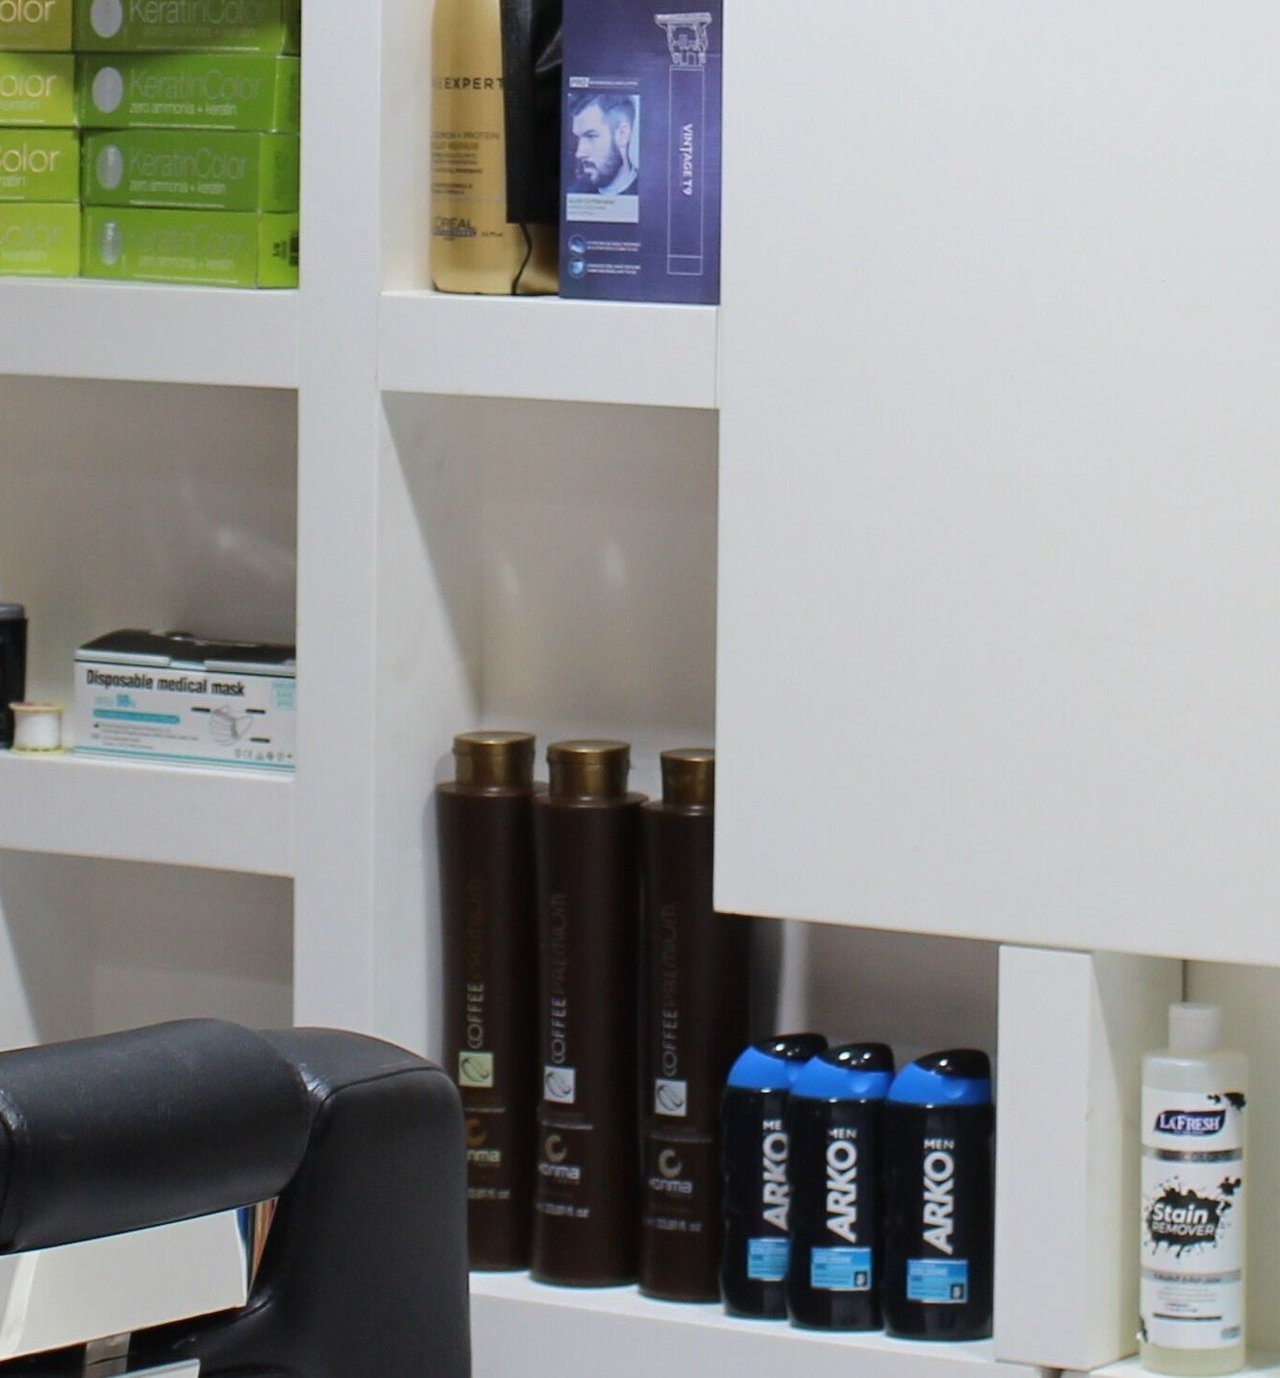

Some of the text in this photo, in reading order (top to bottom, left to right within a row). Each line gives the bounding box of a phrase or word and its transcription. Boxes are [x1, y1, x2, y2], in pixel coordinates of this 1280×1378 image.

[129, 68, 262, 101] KeratinColor
[444, 77, 504, 90] EXPERT
[86, 668, 245, 696] Disposable medical mask
[465, 981, 486, 1049] COFFEE
[549, 997, 567, 1065] COFFEE
[661, 1009, 679, 1077] COFFEE
[762, 1118, 782, 1131] ME
[827, 1128, 857, 1139] MEN
[923, 1138, 955, 1150] MEN
[762, 1131, 790, 1231] ARKO
[826, 1140, 858, 1244] ARKO
[923, 1150, 955, 1256] ARKO
[1153, 1202, 1209, 1225] Stain
[1152, 1222, 1216, 1238] REMOVER
